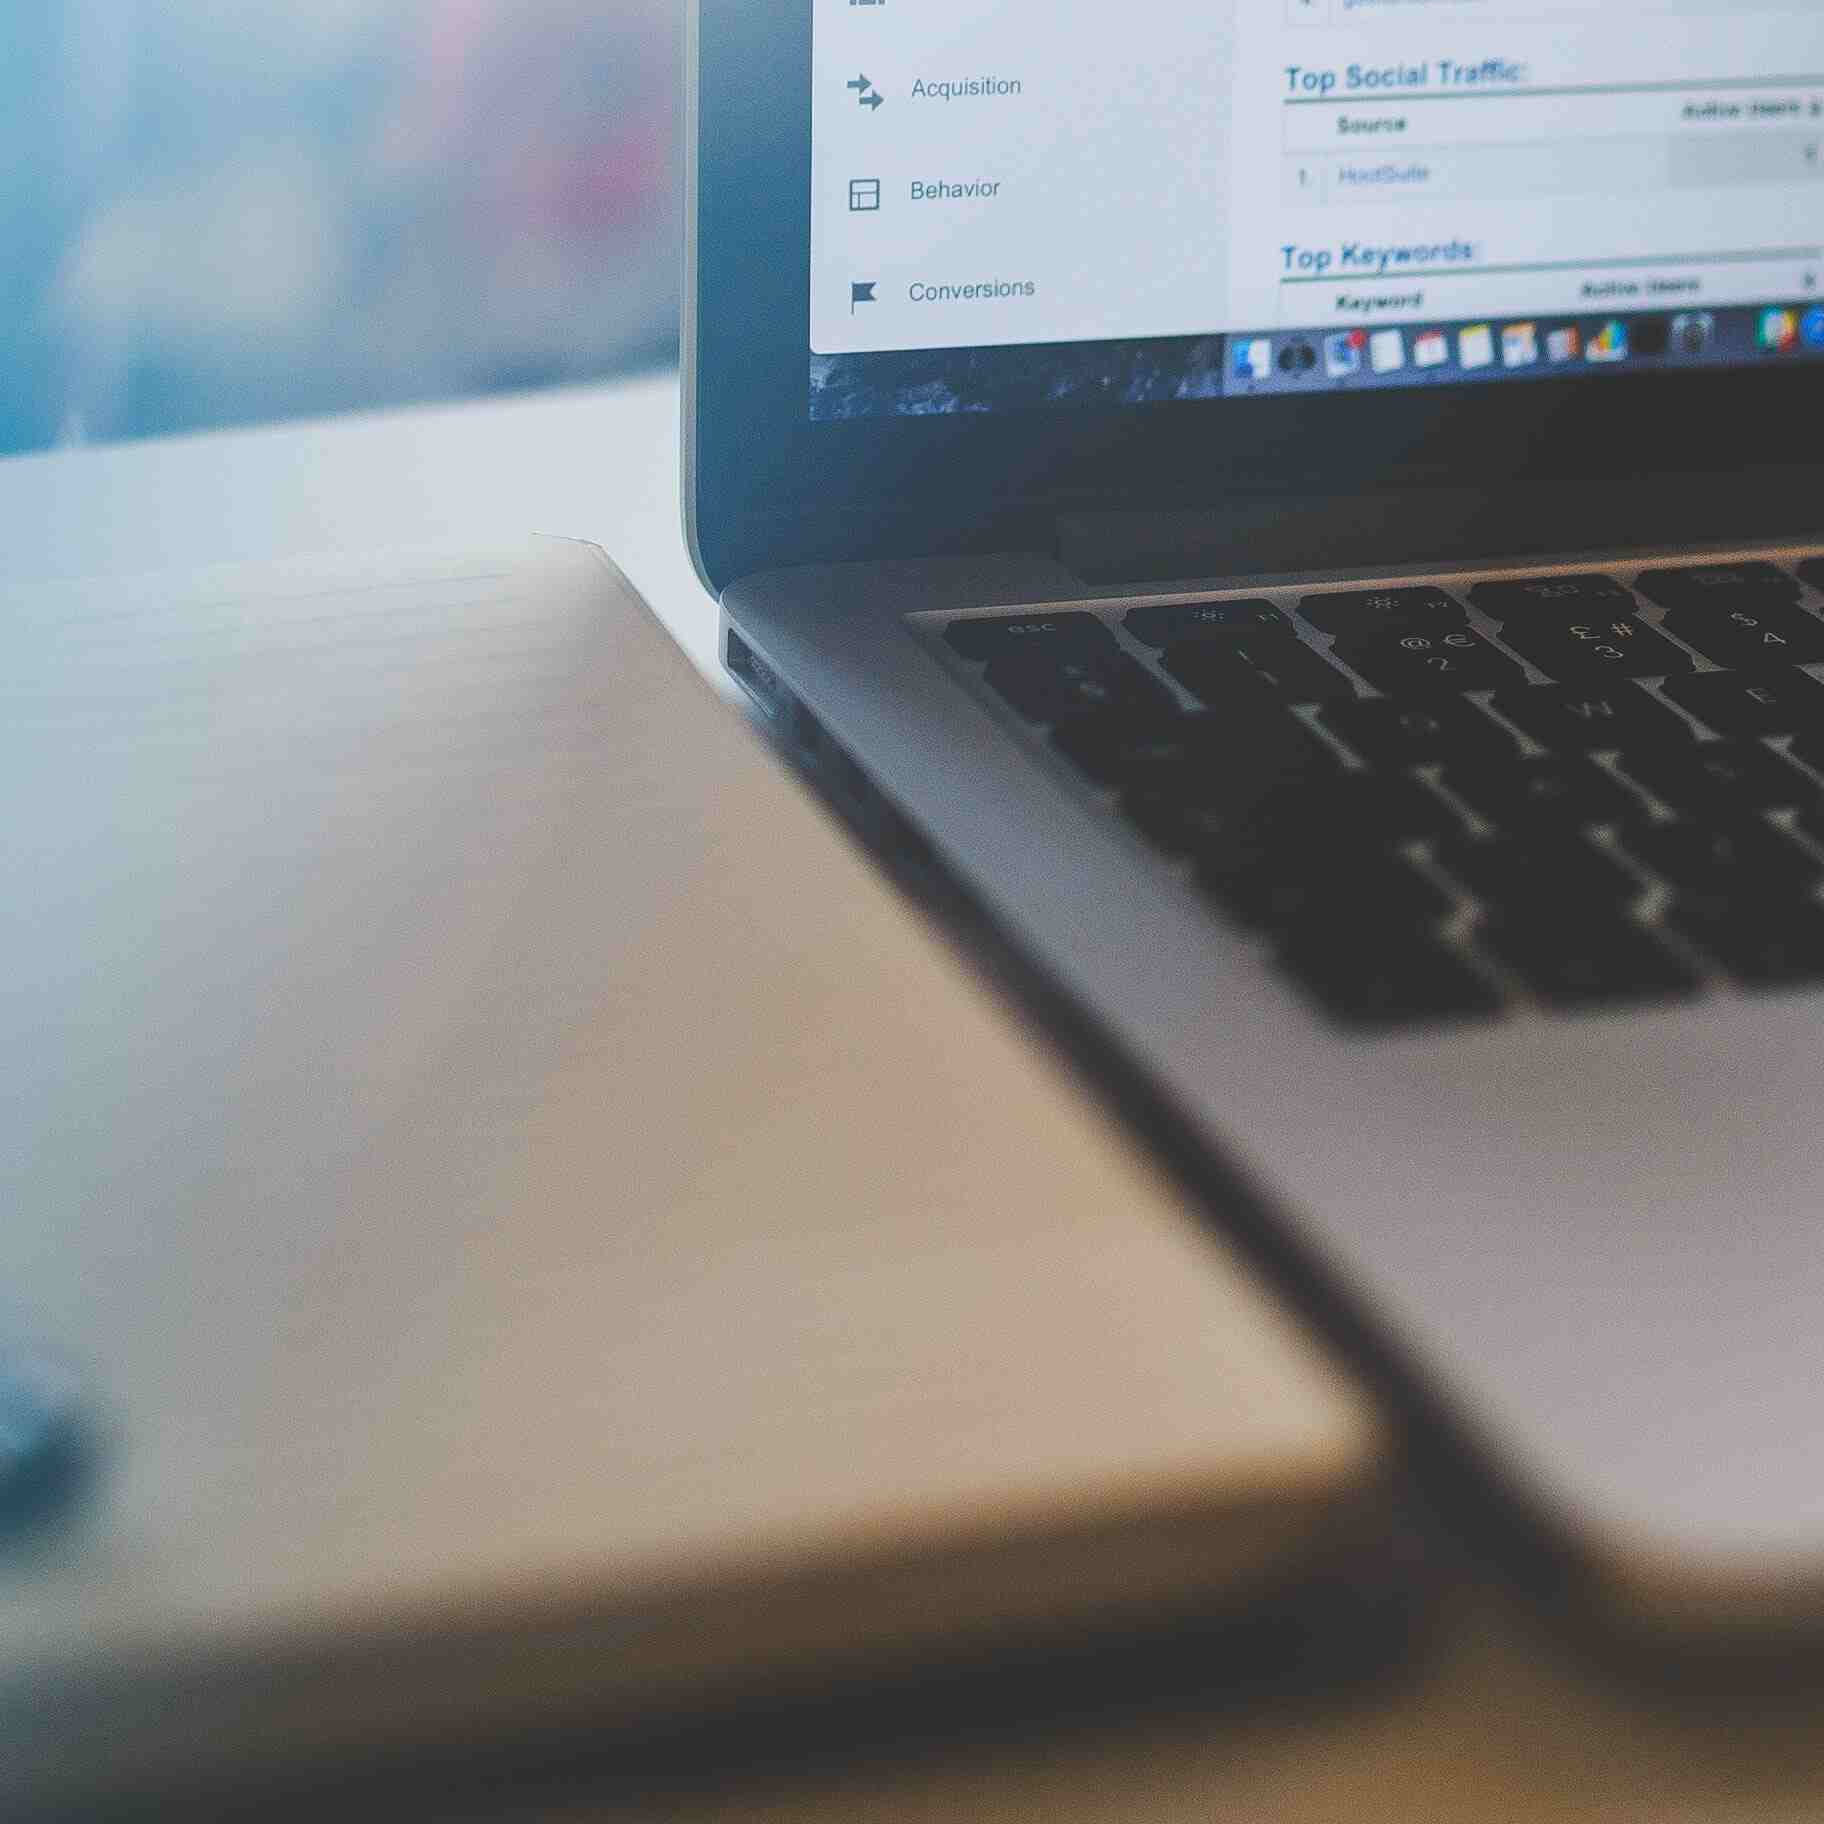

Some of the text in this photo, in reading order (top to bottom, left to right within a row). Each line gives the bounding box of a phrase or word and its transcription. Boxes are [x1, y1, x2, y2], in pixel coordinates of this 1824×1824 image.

[1285, 67, 1335, 93] Top
[1346, 62, 1427, 89] Social
[911, 78, 1022, 103] Acquisition
[911, 179, 1000, 200] Behavior
[1282, 246, 1331, 274] Top
[909, 279, 1035, 302] Conversions
[1008, 622, 1056, 634] esc
